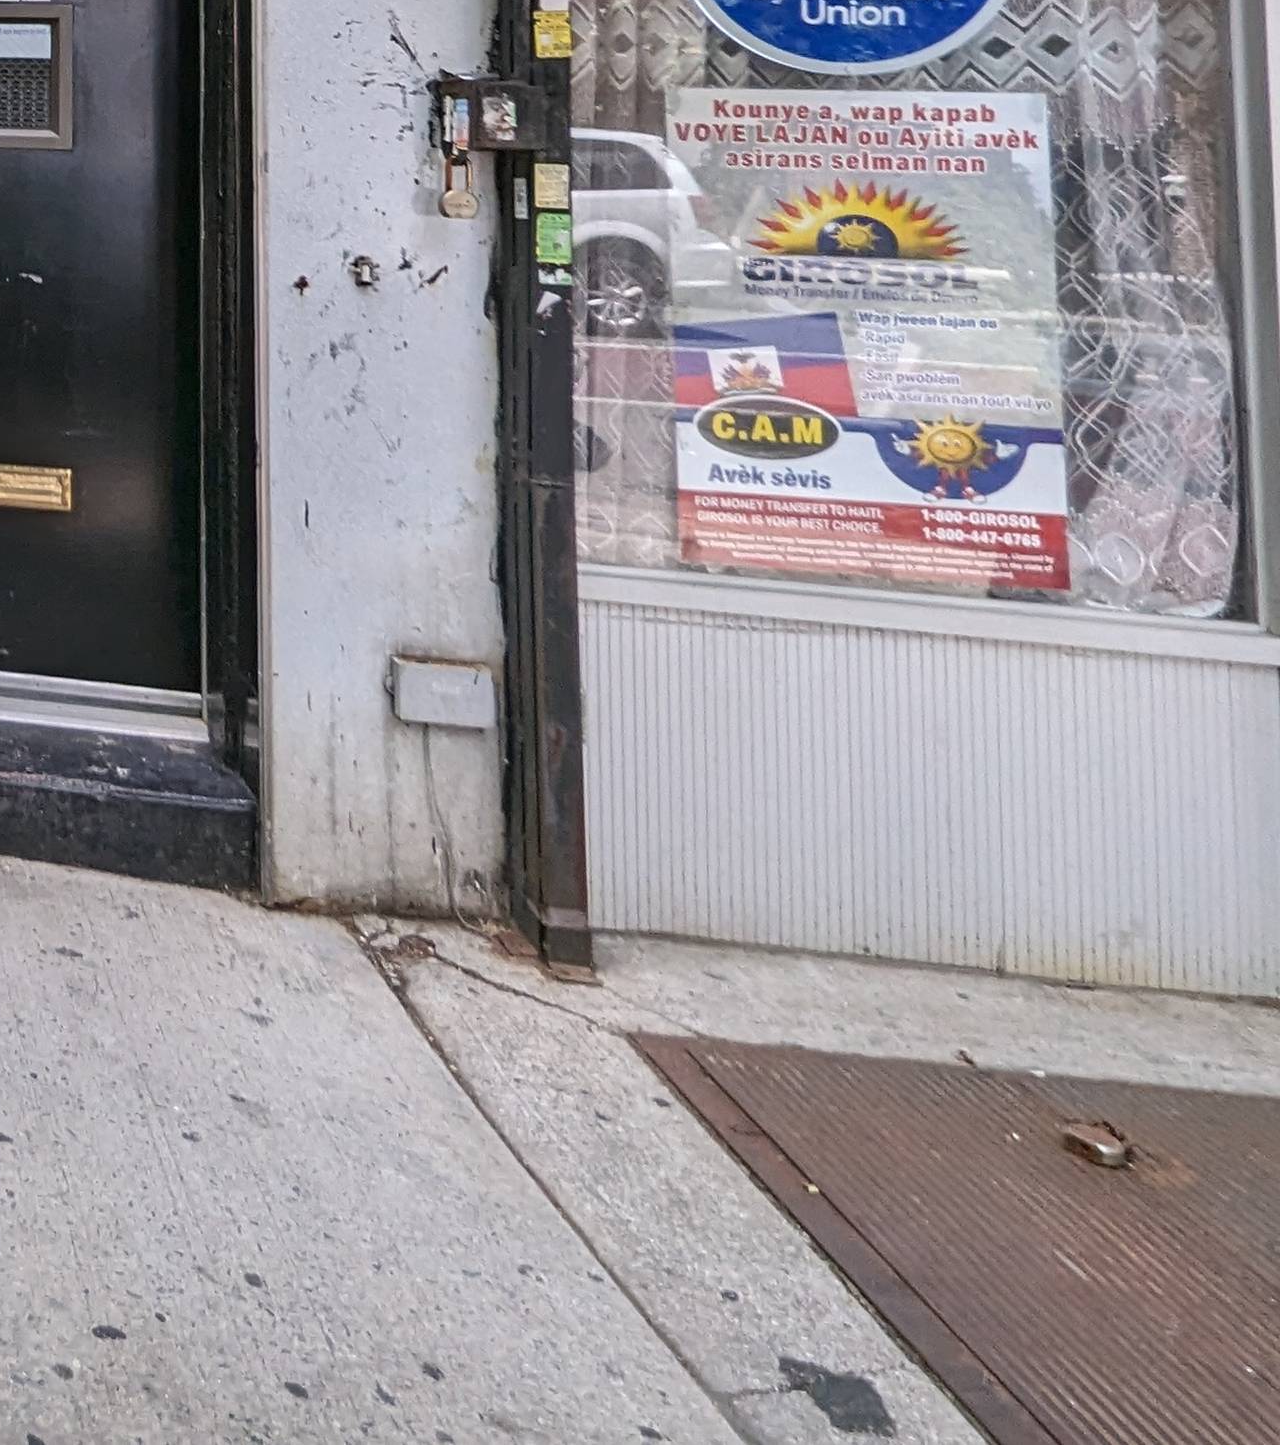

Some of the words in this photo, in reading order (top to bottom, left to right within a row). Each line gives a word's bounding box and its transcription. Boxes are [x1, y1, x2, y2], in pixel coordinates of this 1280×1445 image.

[801, 0, 906, 26] Union
[713, 100, 810, 121] Kounye
[851, 105, 904, 123] wap
[912, 104, 996, 126] kapab
[675, 123, 747, 143] VOYE
[755, 126, 849, 145] LAJAN
[858, 132, 890, 147] ou
[898, 128, 966, 151] Ayiti
[974, 129, 1040, 150] avèk
[726, 151, 824, 170] asirans
[830, 154, 929, 172] selman
[937, 157, 987, 174] nan
[859, 311, 890, 326] Wap
[712, 413, 824, 445] C.A.M
[708, 464, 765, 485] Avèk
[771, 468, 832, 489] sèvis
[694, 496, 719, 508] FOR
[723, 497, 764, 511] MONEY
[766, 501, 828, 515] TRANSFER
[831, 506, 846, 516] TO
[752, 515, 764, 525] IS
